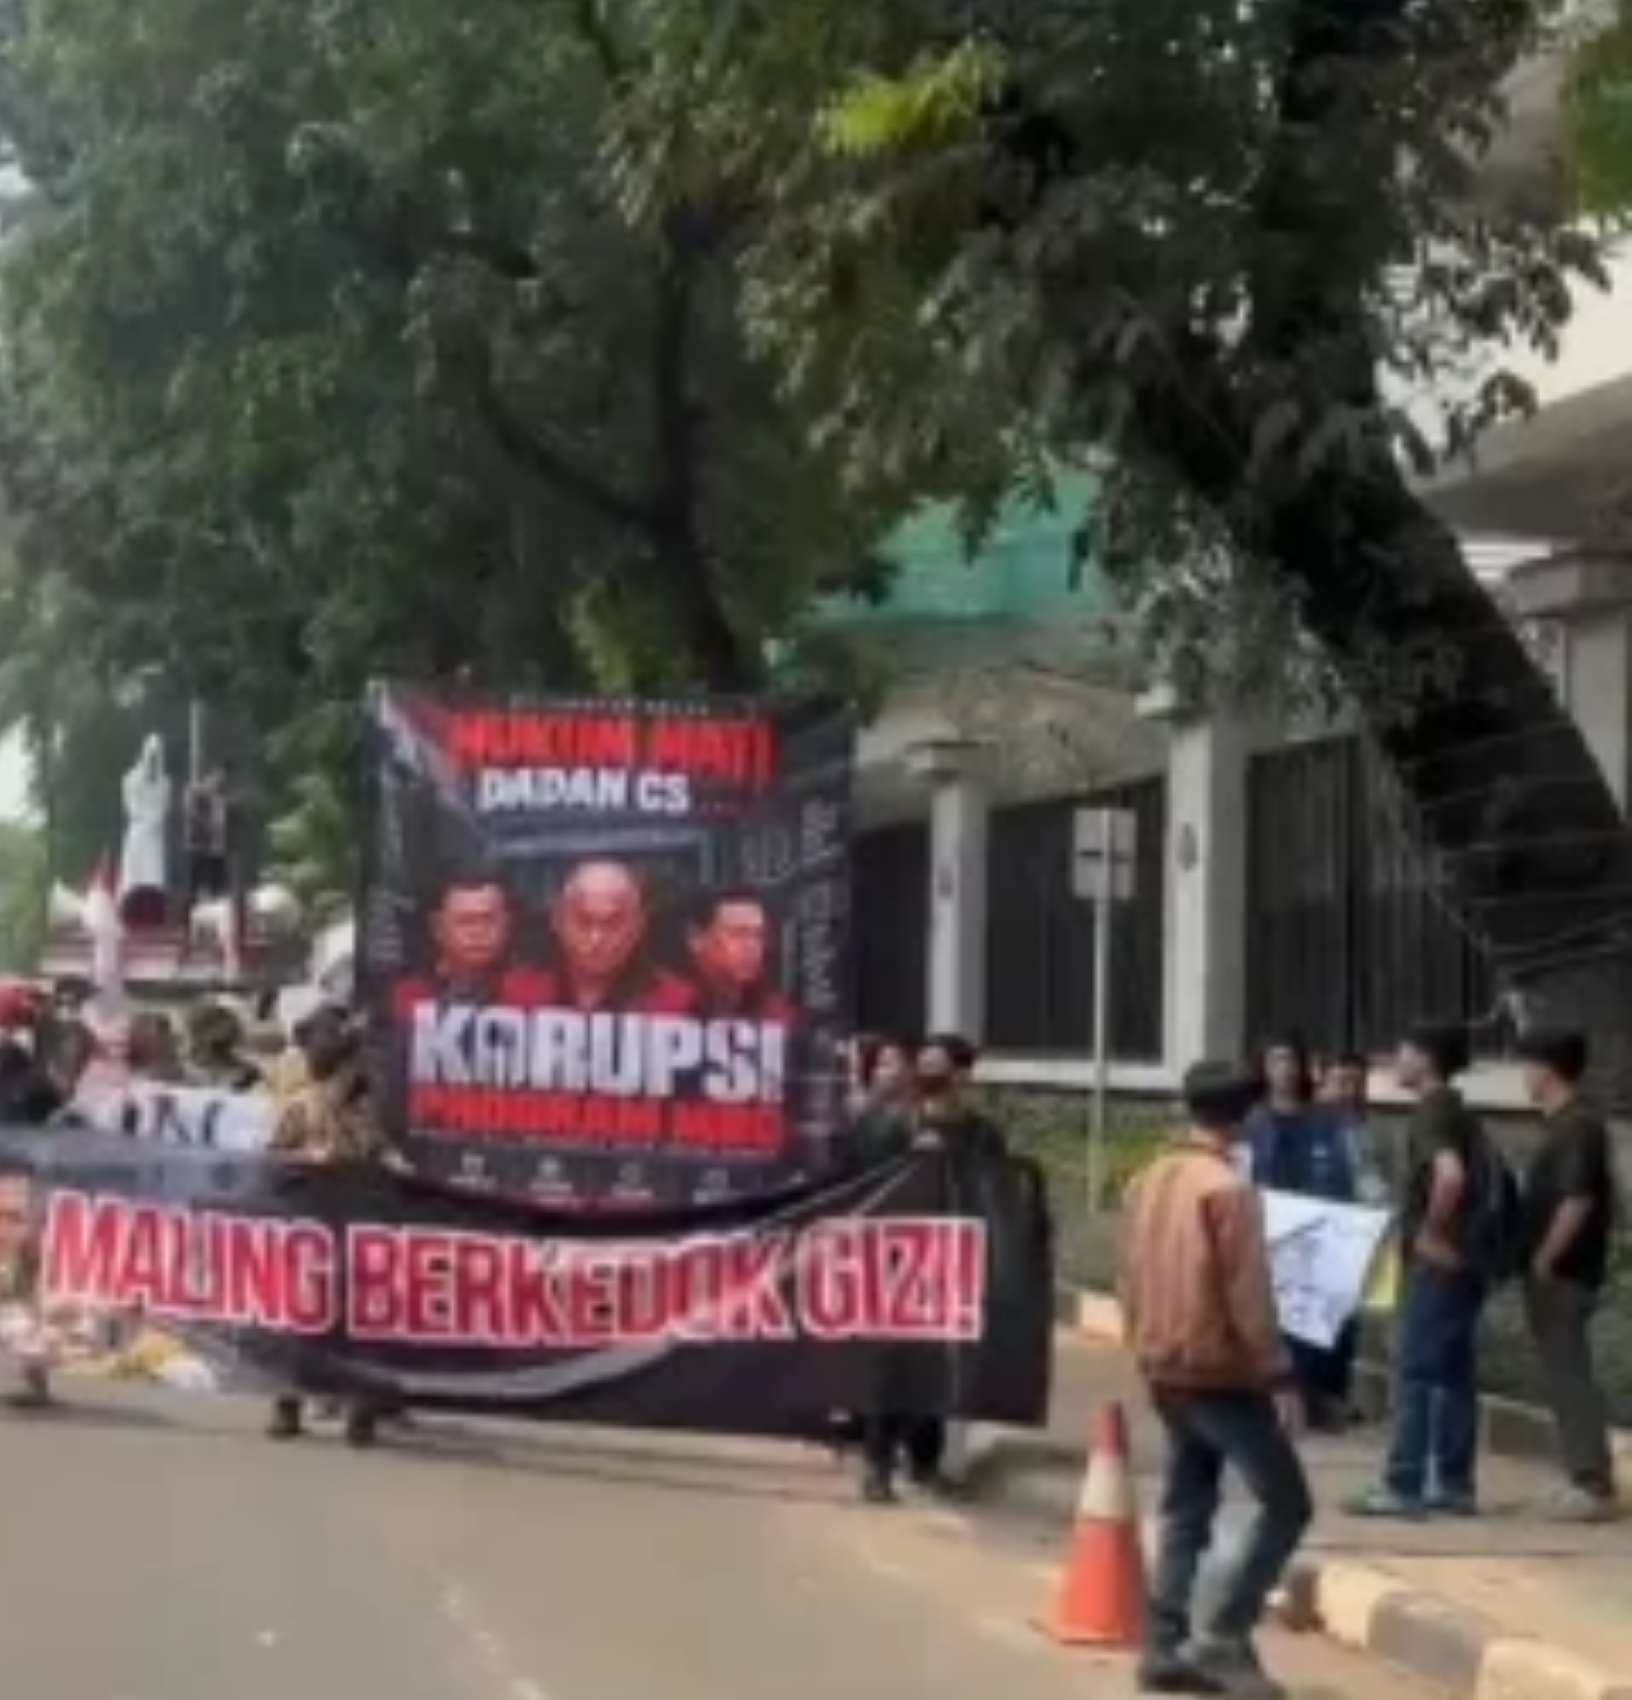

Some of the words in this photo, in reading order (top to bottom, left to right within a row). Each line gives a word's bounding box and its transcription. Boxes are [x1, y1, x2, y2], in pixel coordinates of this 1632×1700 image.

[476, 766, 628, 812] DADAN
[636, 772, 692, 815] CS
[44, 1189, 334, 1333] MALING
[347, 1224, 792, 1345] BERKEDOK
